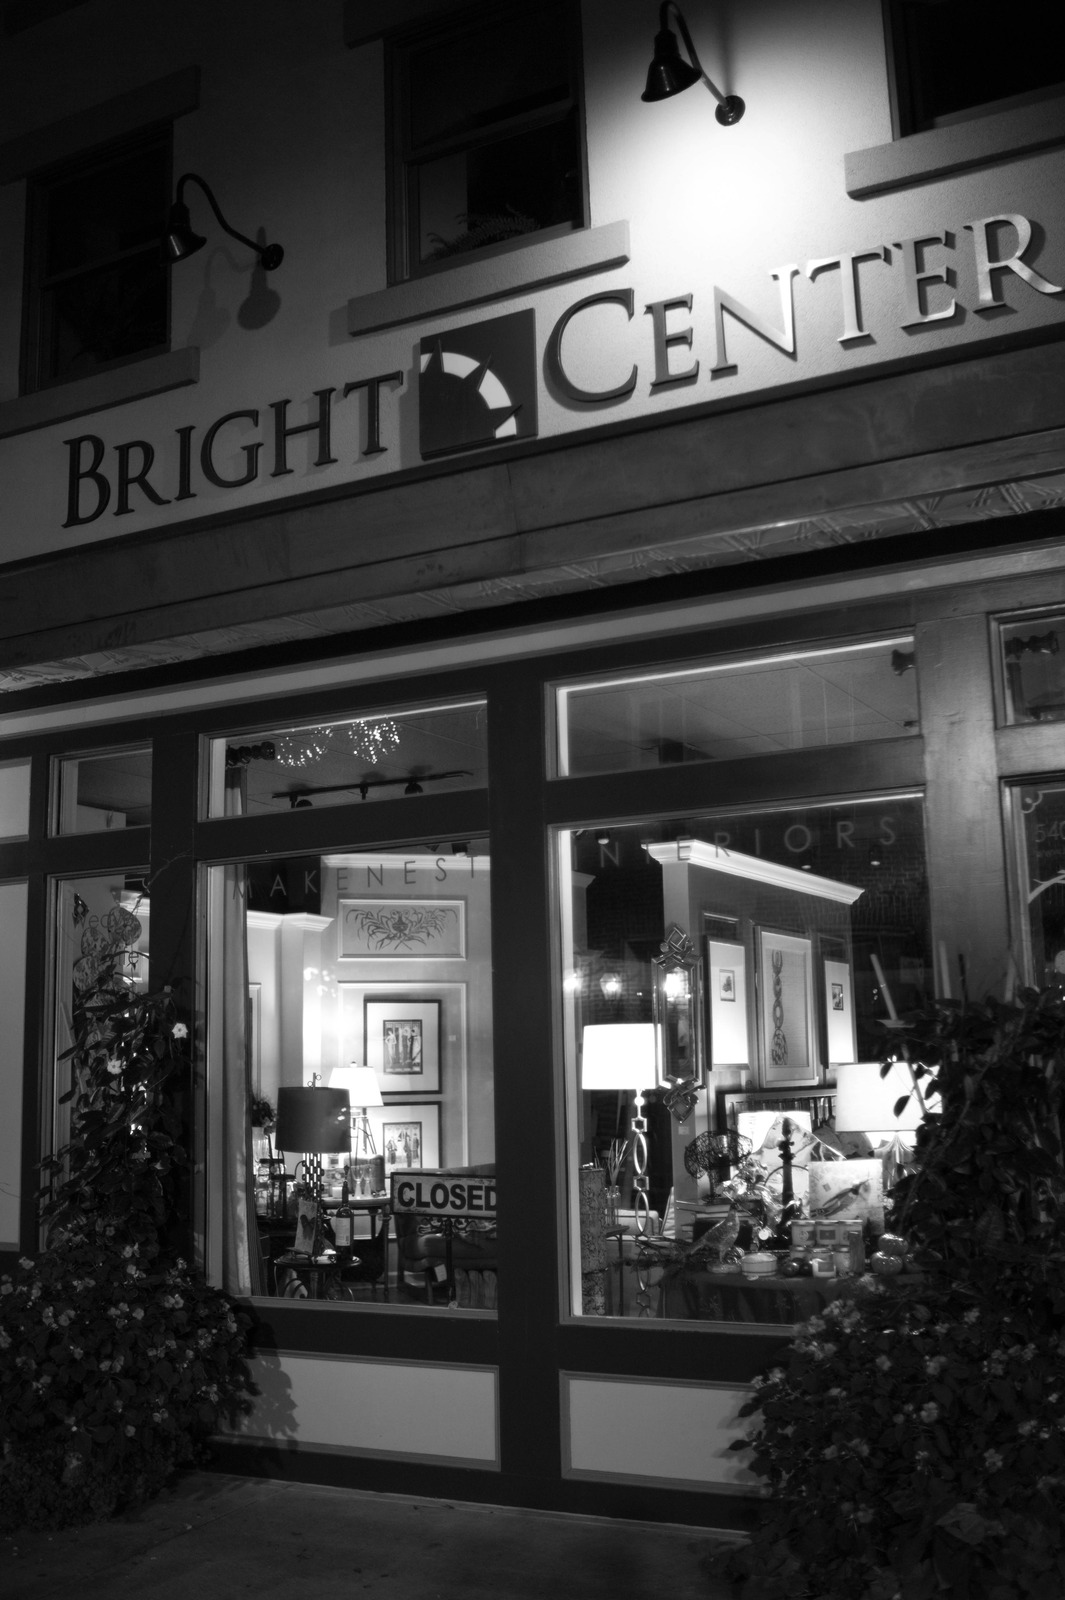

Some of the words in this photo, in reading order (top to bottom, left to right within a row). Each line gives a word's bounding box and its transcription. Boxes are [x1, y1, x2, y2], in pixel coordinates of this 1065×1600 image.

[61, 371, 404, 528] BRIGHT
[543, 213, 1064, 402] CENTER
[572, 816, 897, 871] INTERIORS
[397, 1182, 496, 1212] CLOSED
